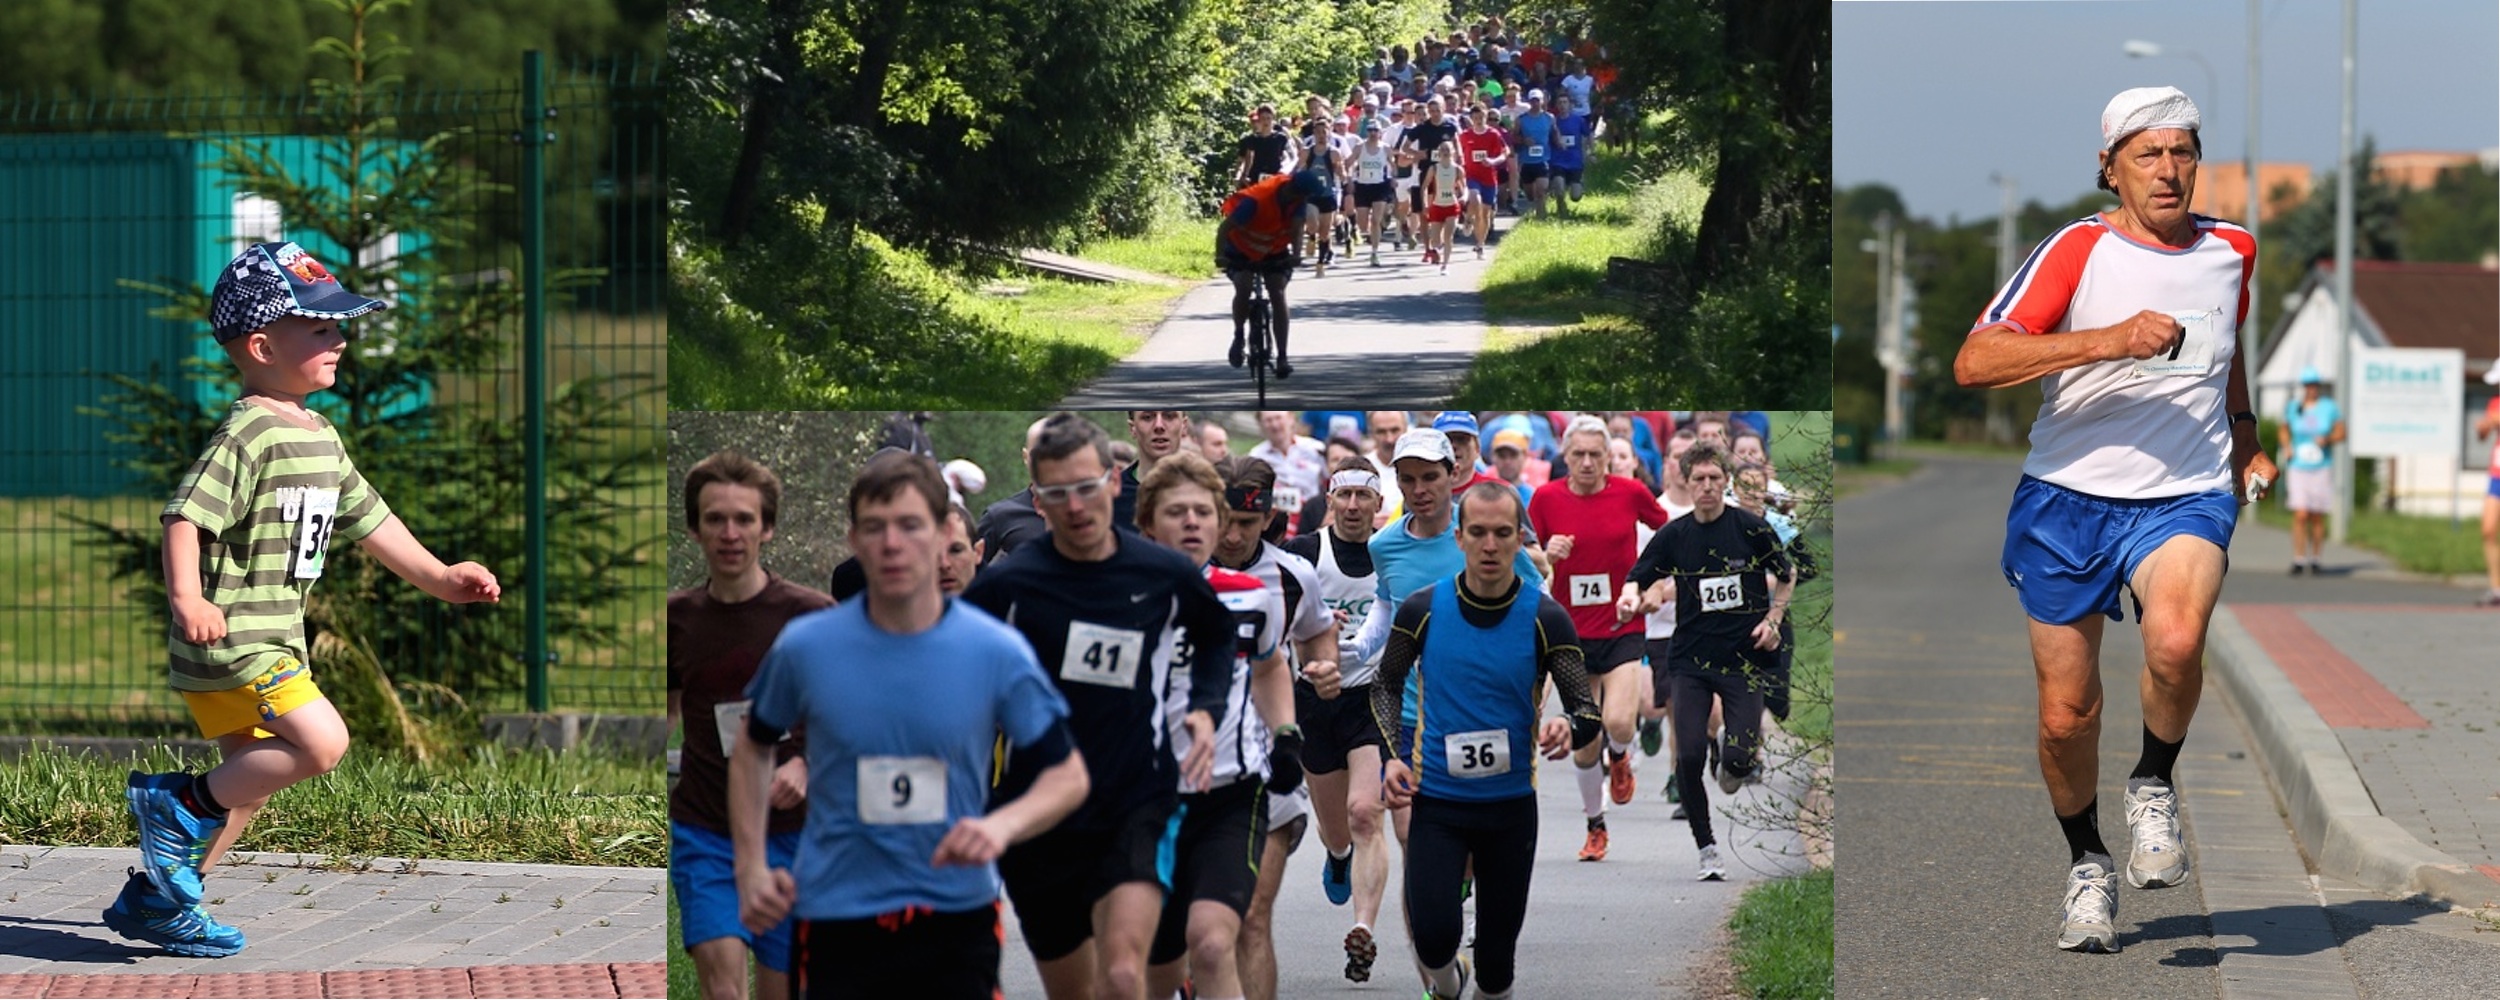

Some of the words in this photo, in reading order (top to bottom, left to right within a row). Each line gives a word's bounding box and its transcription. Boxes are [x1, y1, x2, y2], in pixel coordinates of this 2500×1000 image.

[1579, 582, 1602, 598] 74
[1705, 585, 1737, 603] 266
[1083, 641, 1121, 673] 41
[1462, 743, 1495, 769] 36
[892, 774, 912, 808] 9
